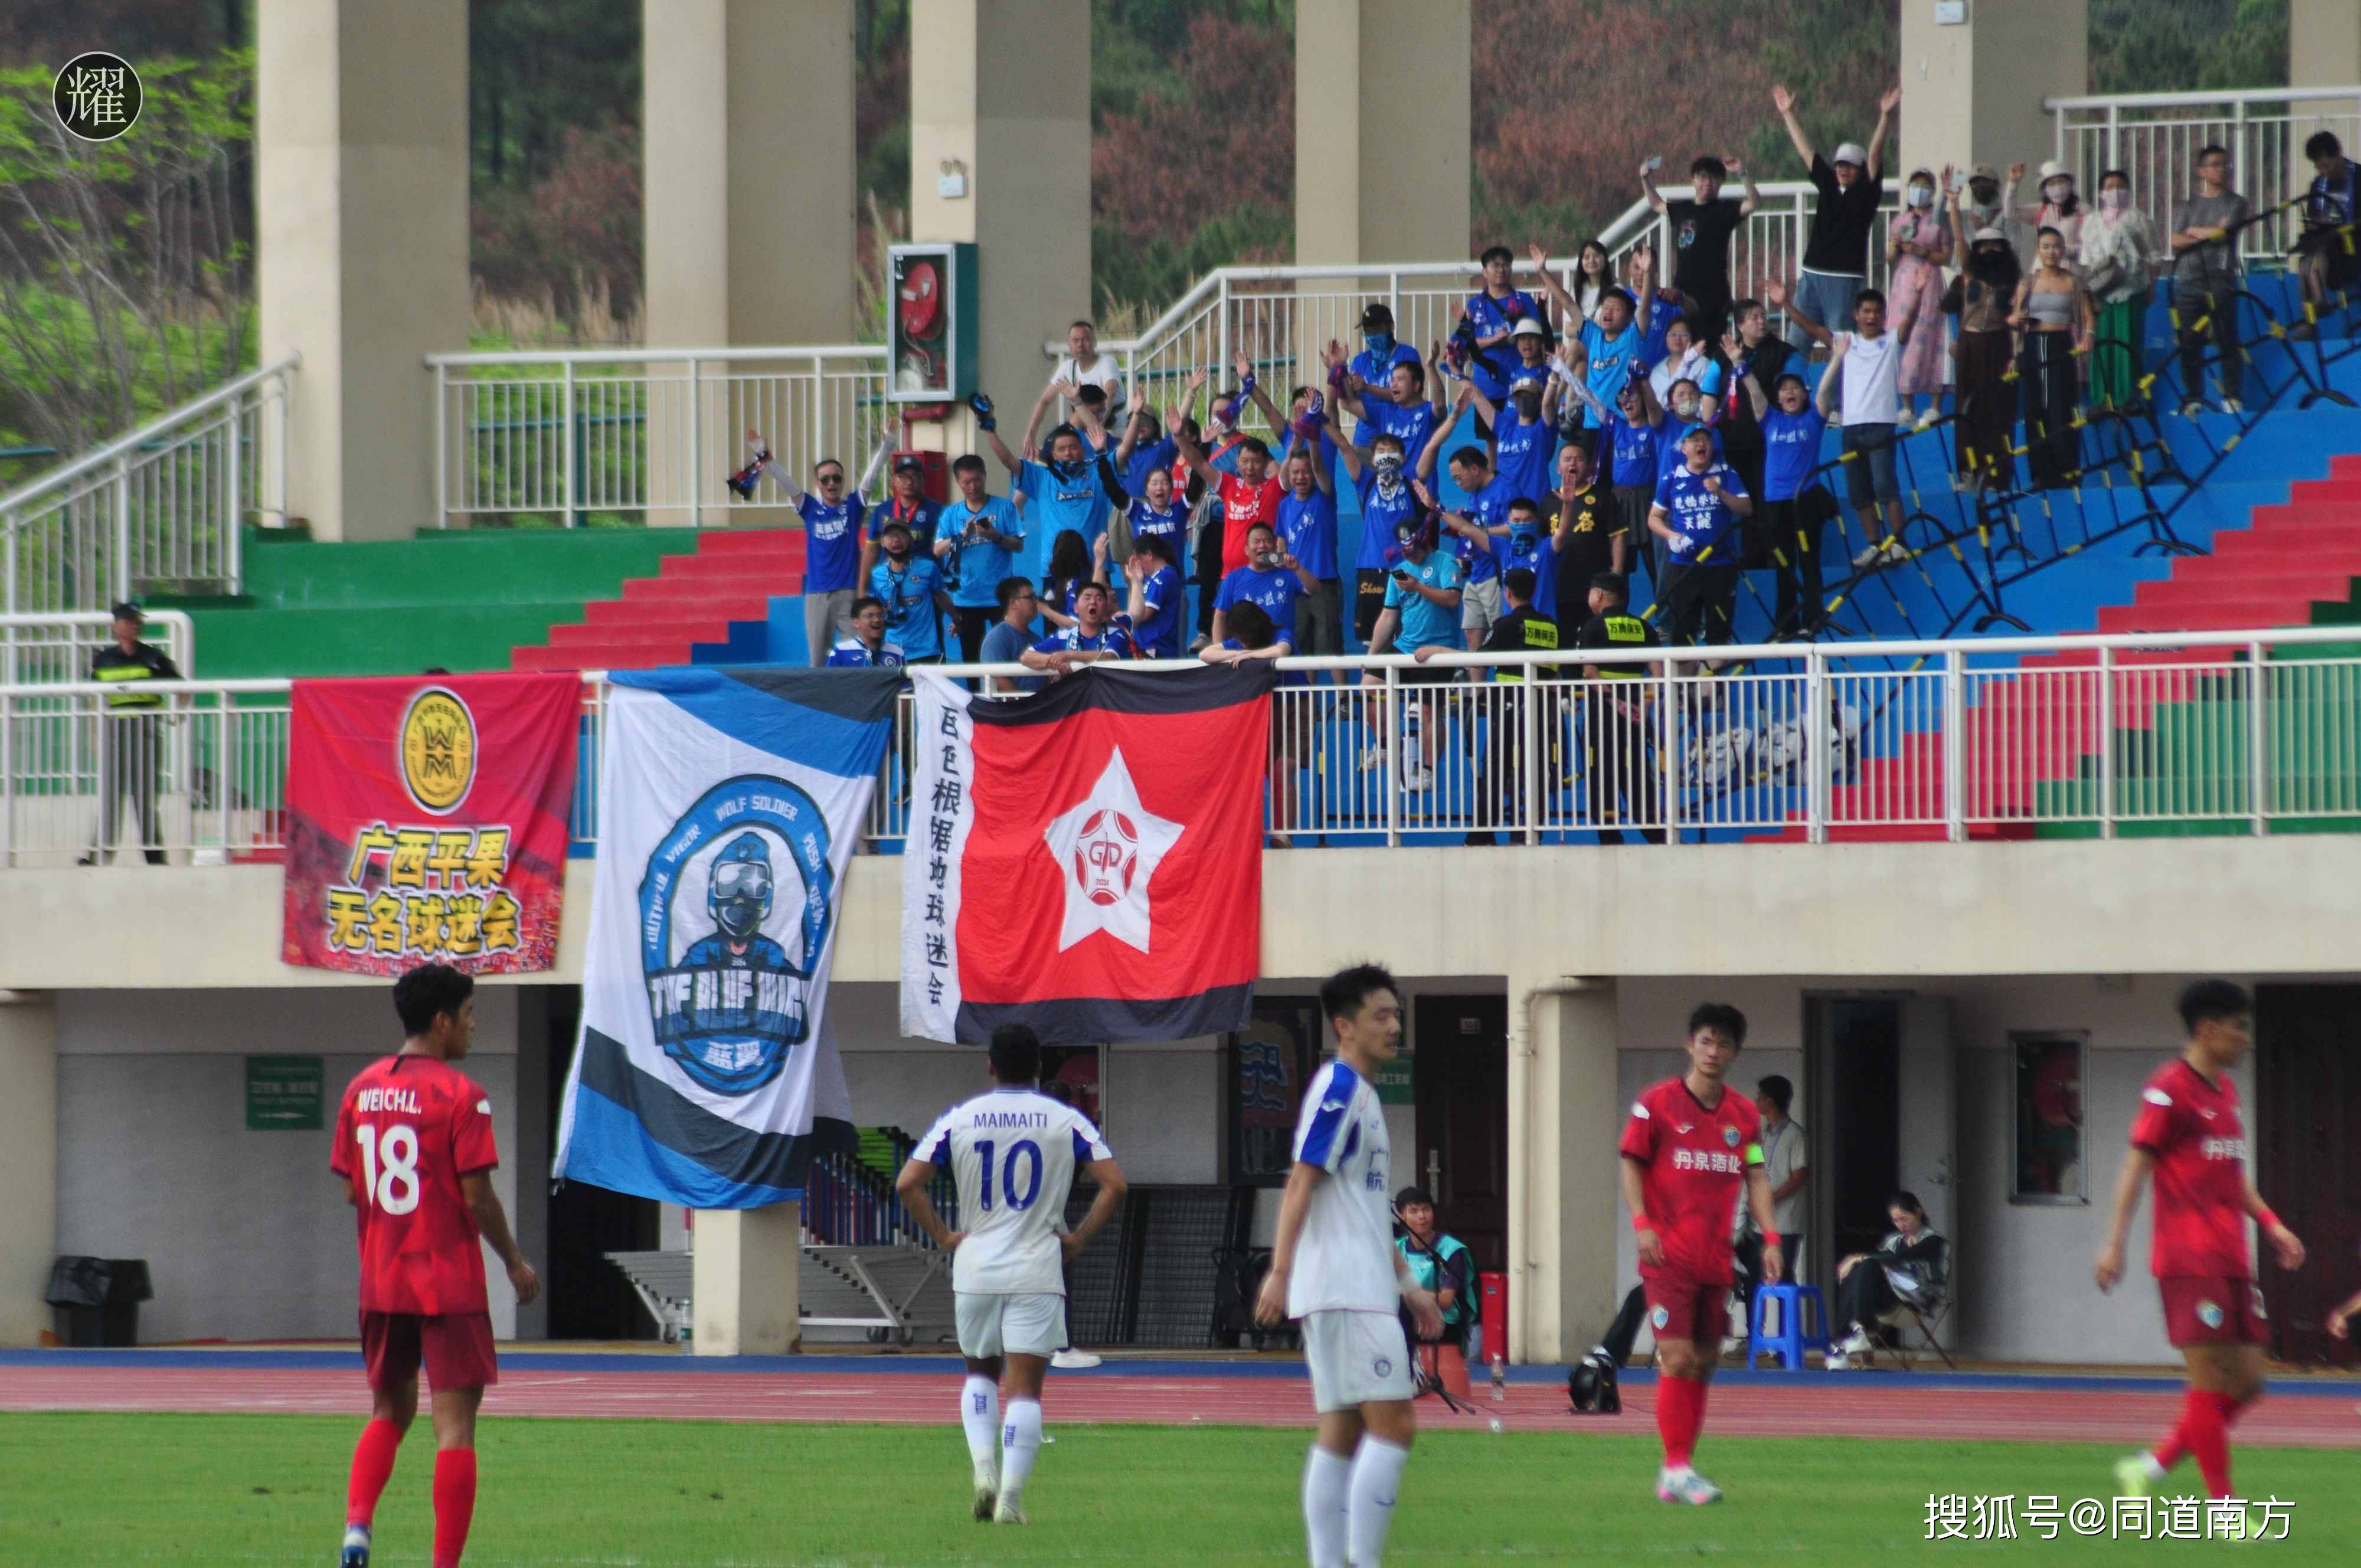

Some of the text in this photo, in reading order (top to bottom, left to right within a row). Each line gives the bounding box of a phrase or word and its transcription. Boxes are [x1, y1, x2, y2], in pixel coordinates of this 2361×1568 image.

[348, 824, 508, 889] 广西平果
[665, 824, 702, 863] VIGOR
[715, 797, 747, 822] WOLF
[750, 796, 799, 822] SOLDIER
[803, 832, 823, 873] PUSH
[924, 705, 962, 1006] 百色根据地球迷会
[329, 888, 519, 955] 无名球迷会
[650, 973, 692, 1040] THE
[694, 970, 754, 1031] BLUE
[974, 1112, 1048, 1130] MAIMAITI
[357, 1124, 420, 1215] 18
[973, 1139, 1043, 1212] 10
[1673, 1151, 1742, 1174] 丹泉酒业
